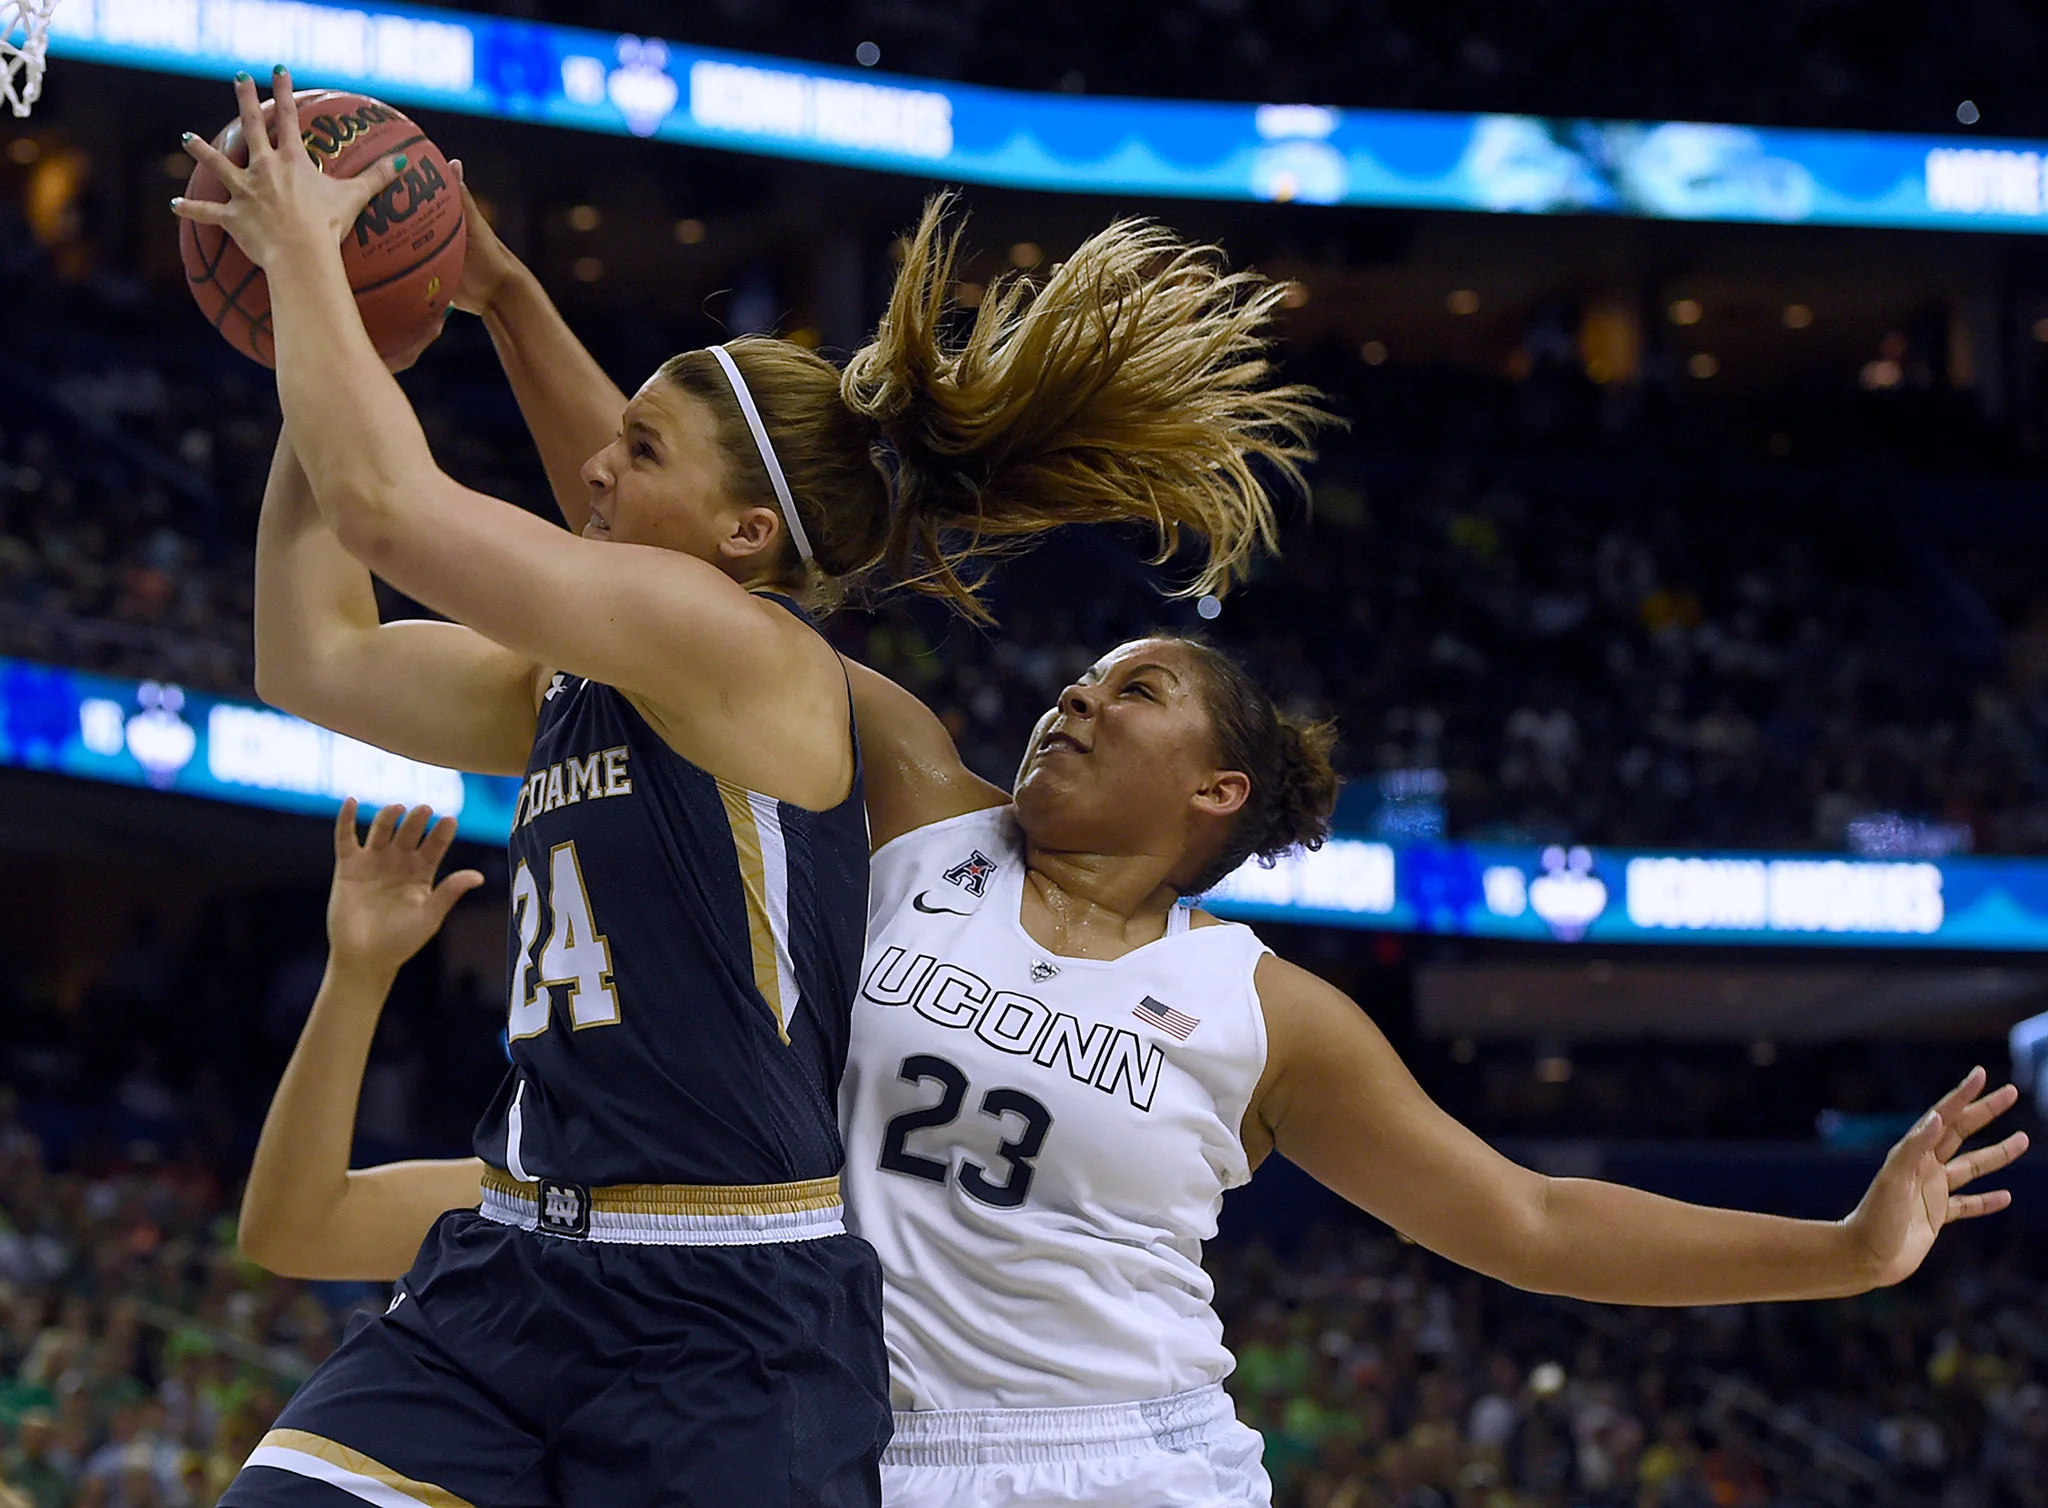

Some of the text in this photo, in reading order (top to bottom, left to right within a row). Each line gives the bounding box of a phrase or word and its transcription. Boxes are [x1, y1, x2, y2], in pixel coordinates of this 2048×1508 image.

[355, 156, 446, 247] NCAA
[530, 745, 632, 818] DAME
[508, 839, 622, 1044] 24
[861, 946, 1165, 1113] UCONN
[876, 1053, 1055, 1211] 23
